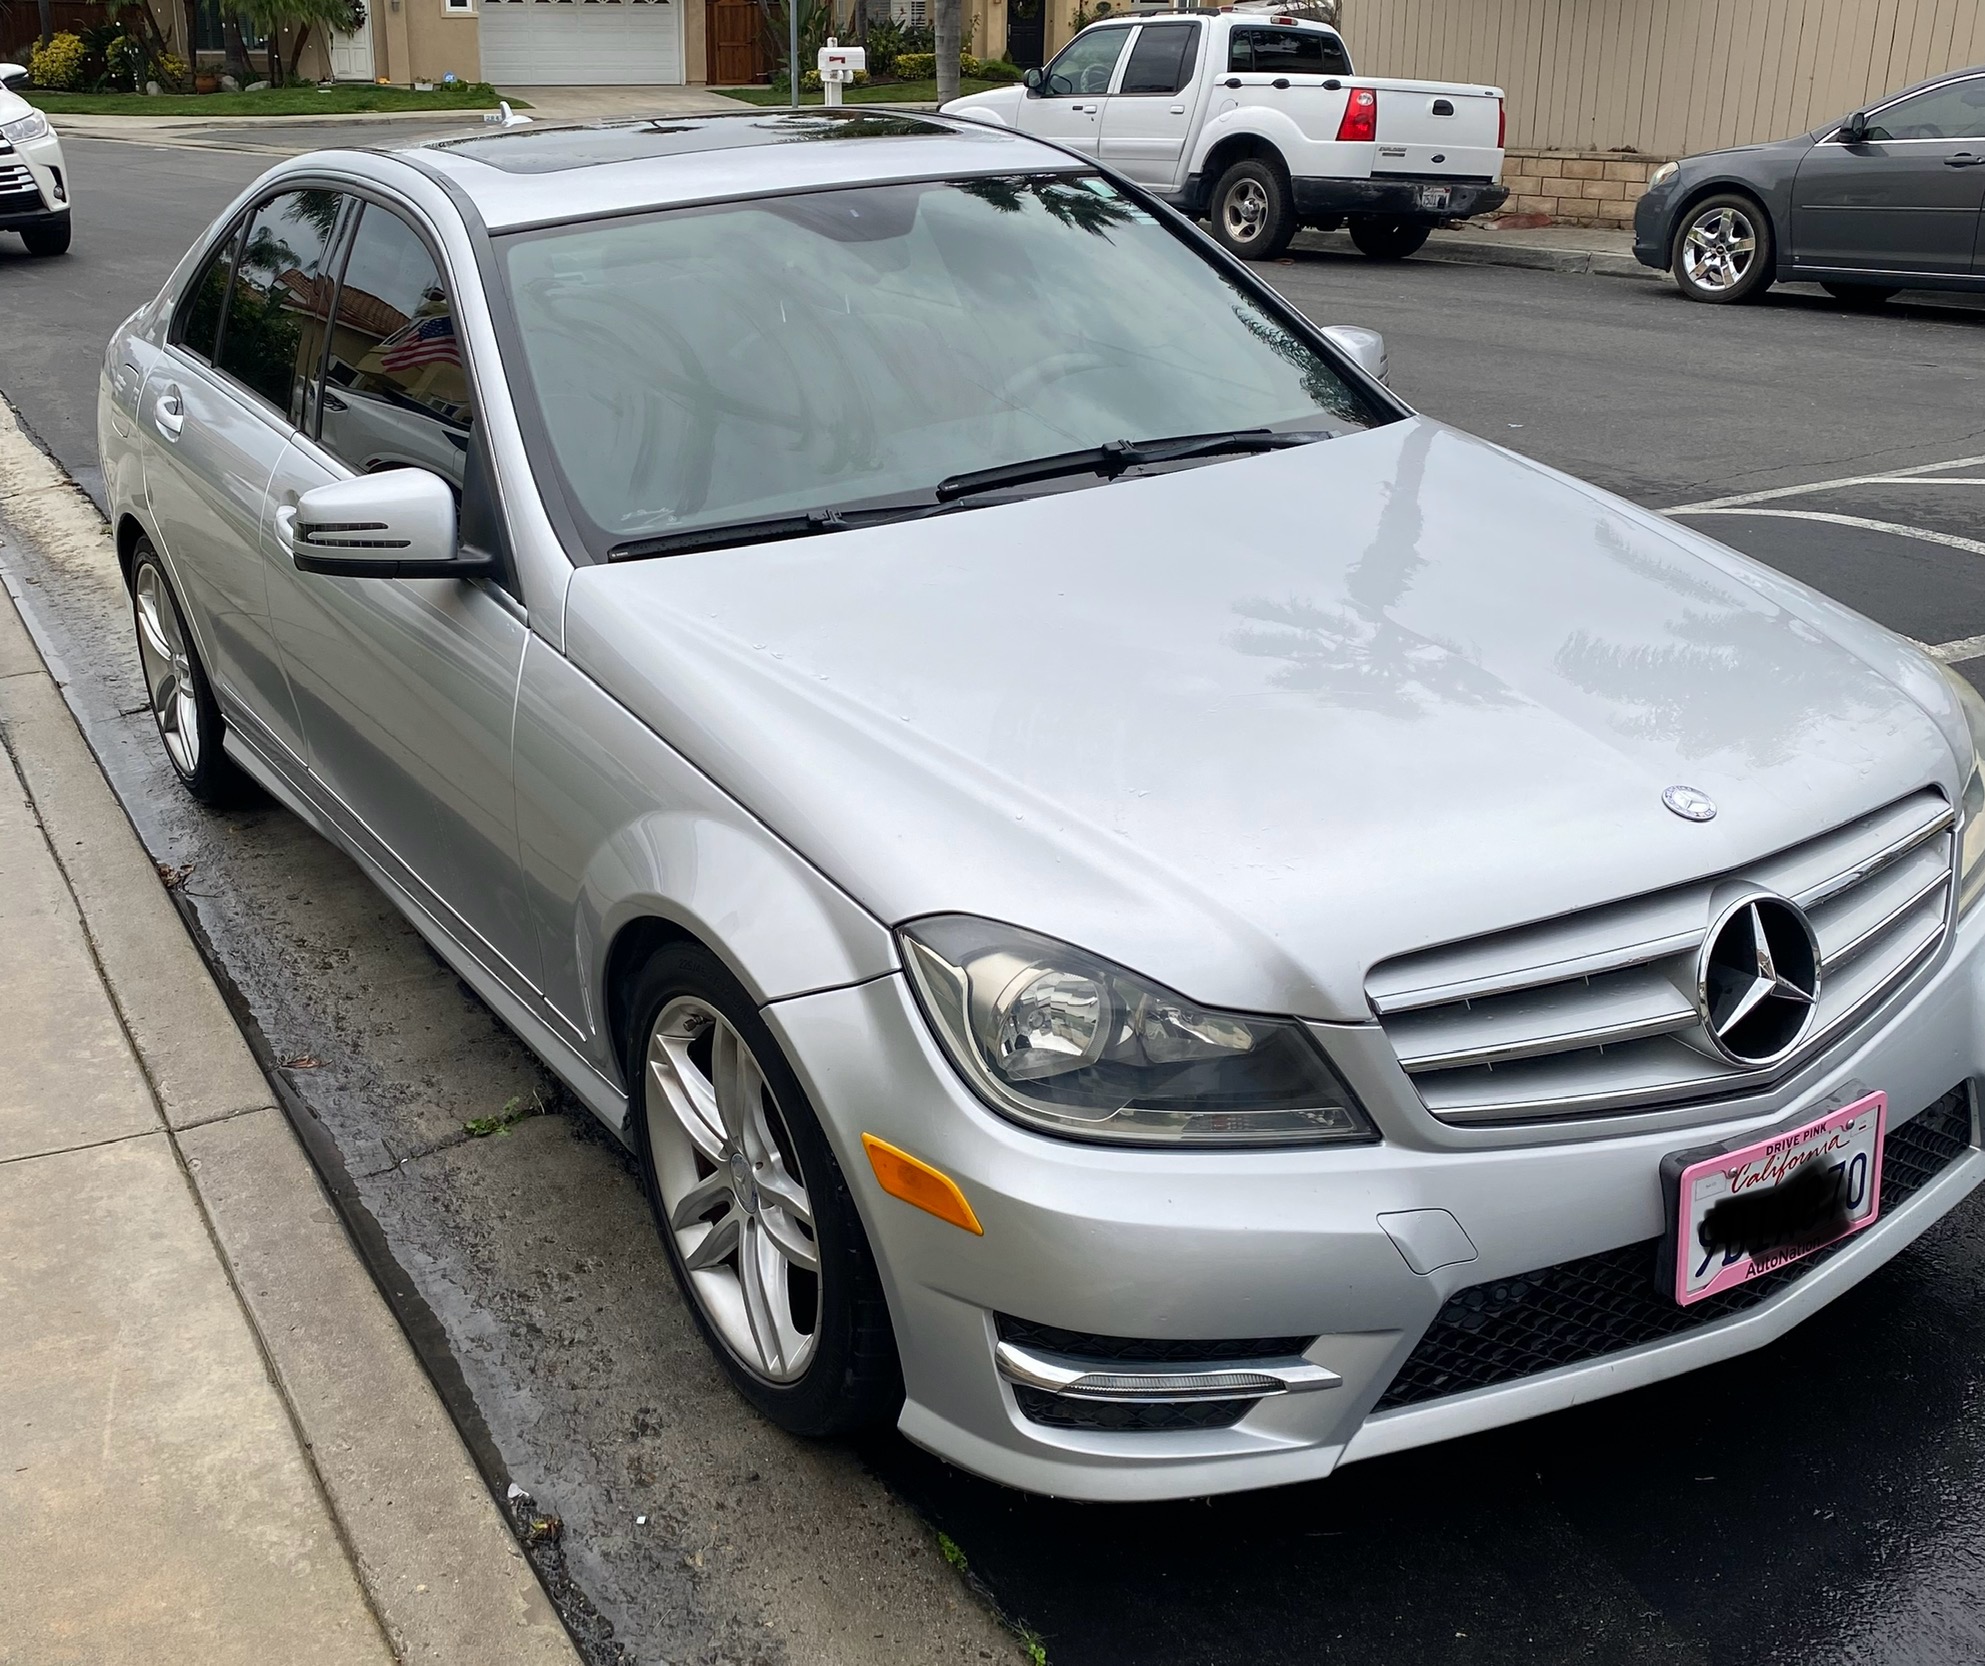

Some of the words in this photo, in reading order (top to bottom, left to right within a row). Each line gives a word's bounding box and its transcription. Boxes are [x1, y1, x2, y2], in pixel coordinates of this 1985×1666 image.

[1766, 1134, 1800, 1156] DRIVE
[1803, 1122, 1827, 1141] PINK
[1732, 1130, 1851, 1193] California
[1745, 1236, 1820, 1279] AutoNation
